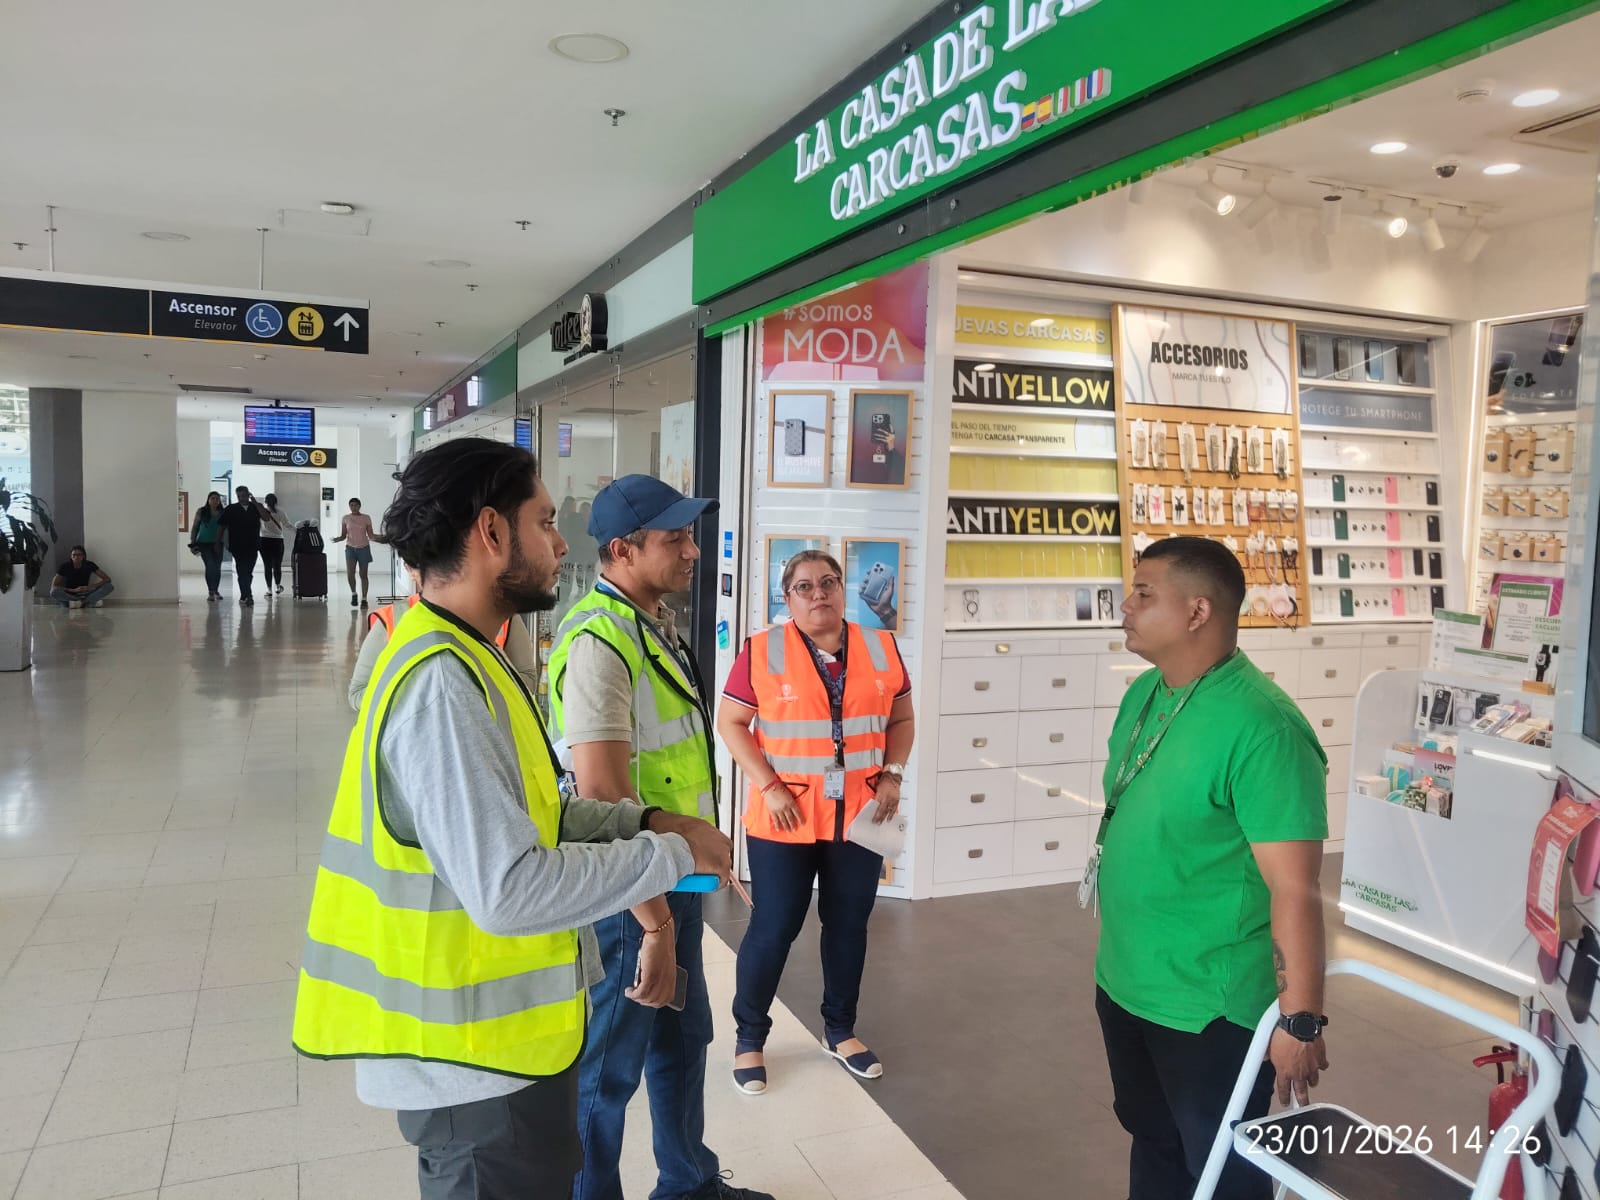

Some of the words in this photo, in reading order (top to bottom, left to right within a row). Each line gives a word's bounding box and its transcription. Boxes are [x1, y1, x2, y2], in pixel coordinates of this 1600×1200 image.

[794, 118, 836, 183] LA
[840, 54, 932, 149] CASA
[932, 5, 995, 98] DE
[830, 69, 1027, 220] CARCASAS
[169, 298, 237, 317] Ascensor
[194, 318, 237, 331] Elevator
[1012, 320, 1106, 344] CARCASAS
[783, 327, 905, 364] MODA
[1150, 341, 1249, 370] ACCESORIOS
[1172, 372, 1198, 381] MARCA
[1302, 403, 1341, 416] ROTEGE
[1361, 408, 1426, 421] SMARTPHONE
[961, 422, 978, 431] PASO
[980, 423, 992, 432] DEL
[993, 424, 1017, 432] TIEMPO
[984, 433, 1015, 442] CARCASA
[1017, 434, 1066, 444] TRANSPARENTE
[258, 448, 288, 457] Ascensor
[946, 506, 1116, 535] ANTIYELLOW
[1356, 891, 1397, 912] CARCASAS
[1359, 884, 1379, 898] CASA
[1380, 891, 1392, 901] DE
[1395, 897, 1410, 909] LAS
